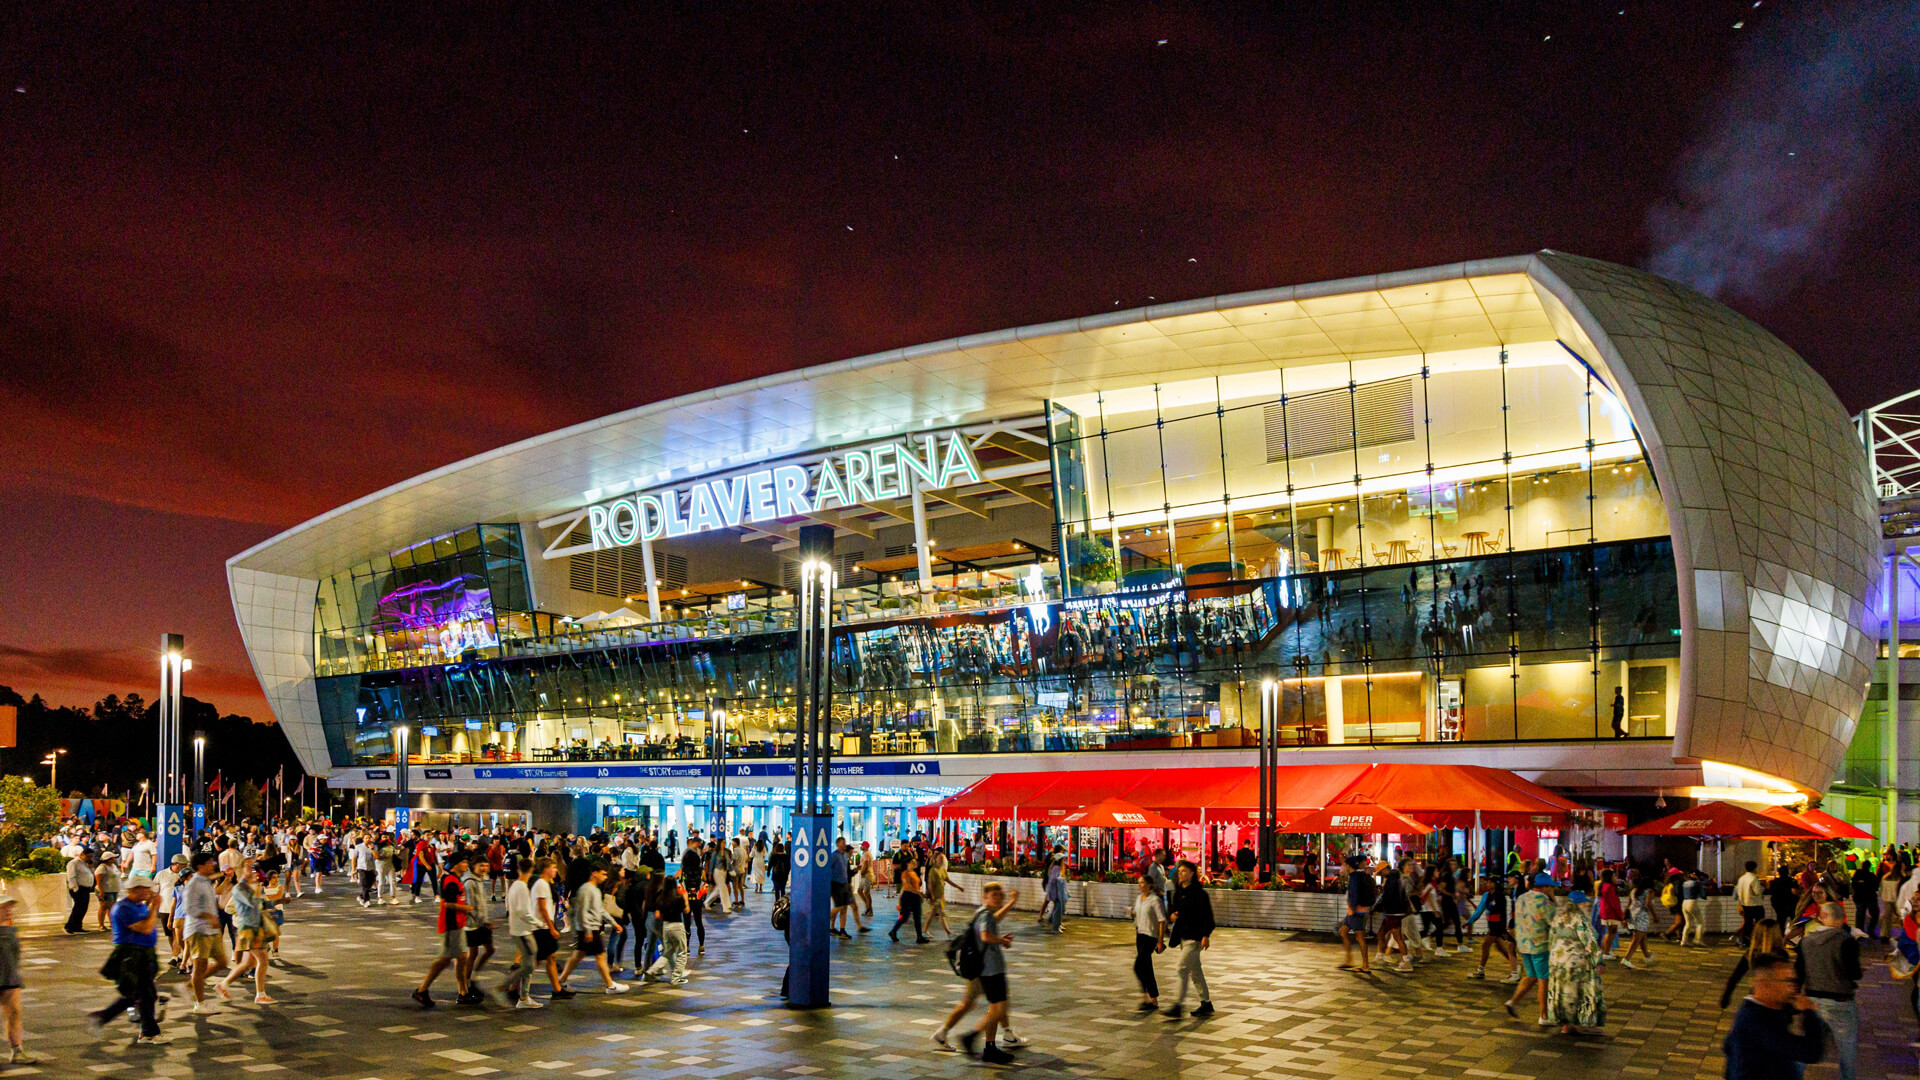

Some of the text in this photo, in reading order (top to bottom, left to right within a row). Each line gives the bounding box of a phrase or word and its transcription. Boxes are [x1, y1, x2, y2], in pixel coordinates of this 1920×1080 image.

[598, 768, 609, 777] AO
[648, 767, 671, 776] STORY
[687, 768, 702, 776] HERE
[737, 765, 751, 776] AO
[829, 767, 847, 775] TARTS
[847, 766, 864, 775] HERE
[909, 762, 927, 774] AO
[482, 769, 492, 778] AO
[524, 769, 544, 777] STORY
[1118, 813, 1144, 821] PIPER
[1339, 815, 1373, 823] PIPER
[167, 811, 181, 836] AO
[794, 826, 810, 868] AO
[815, 827, 829, 868] AO
